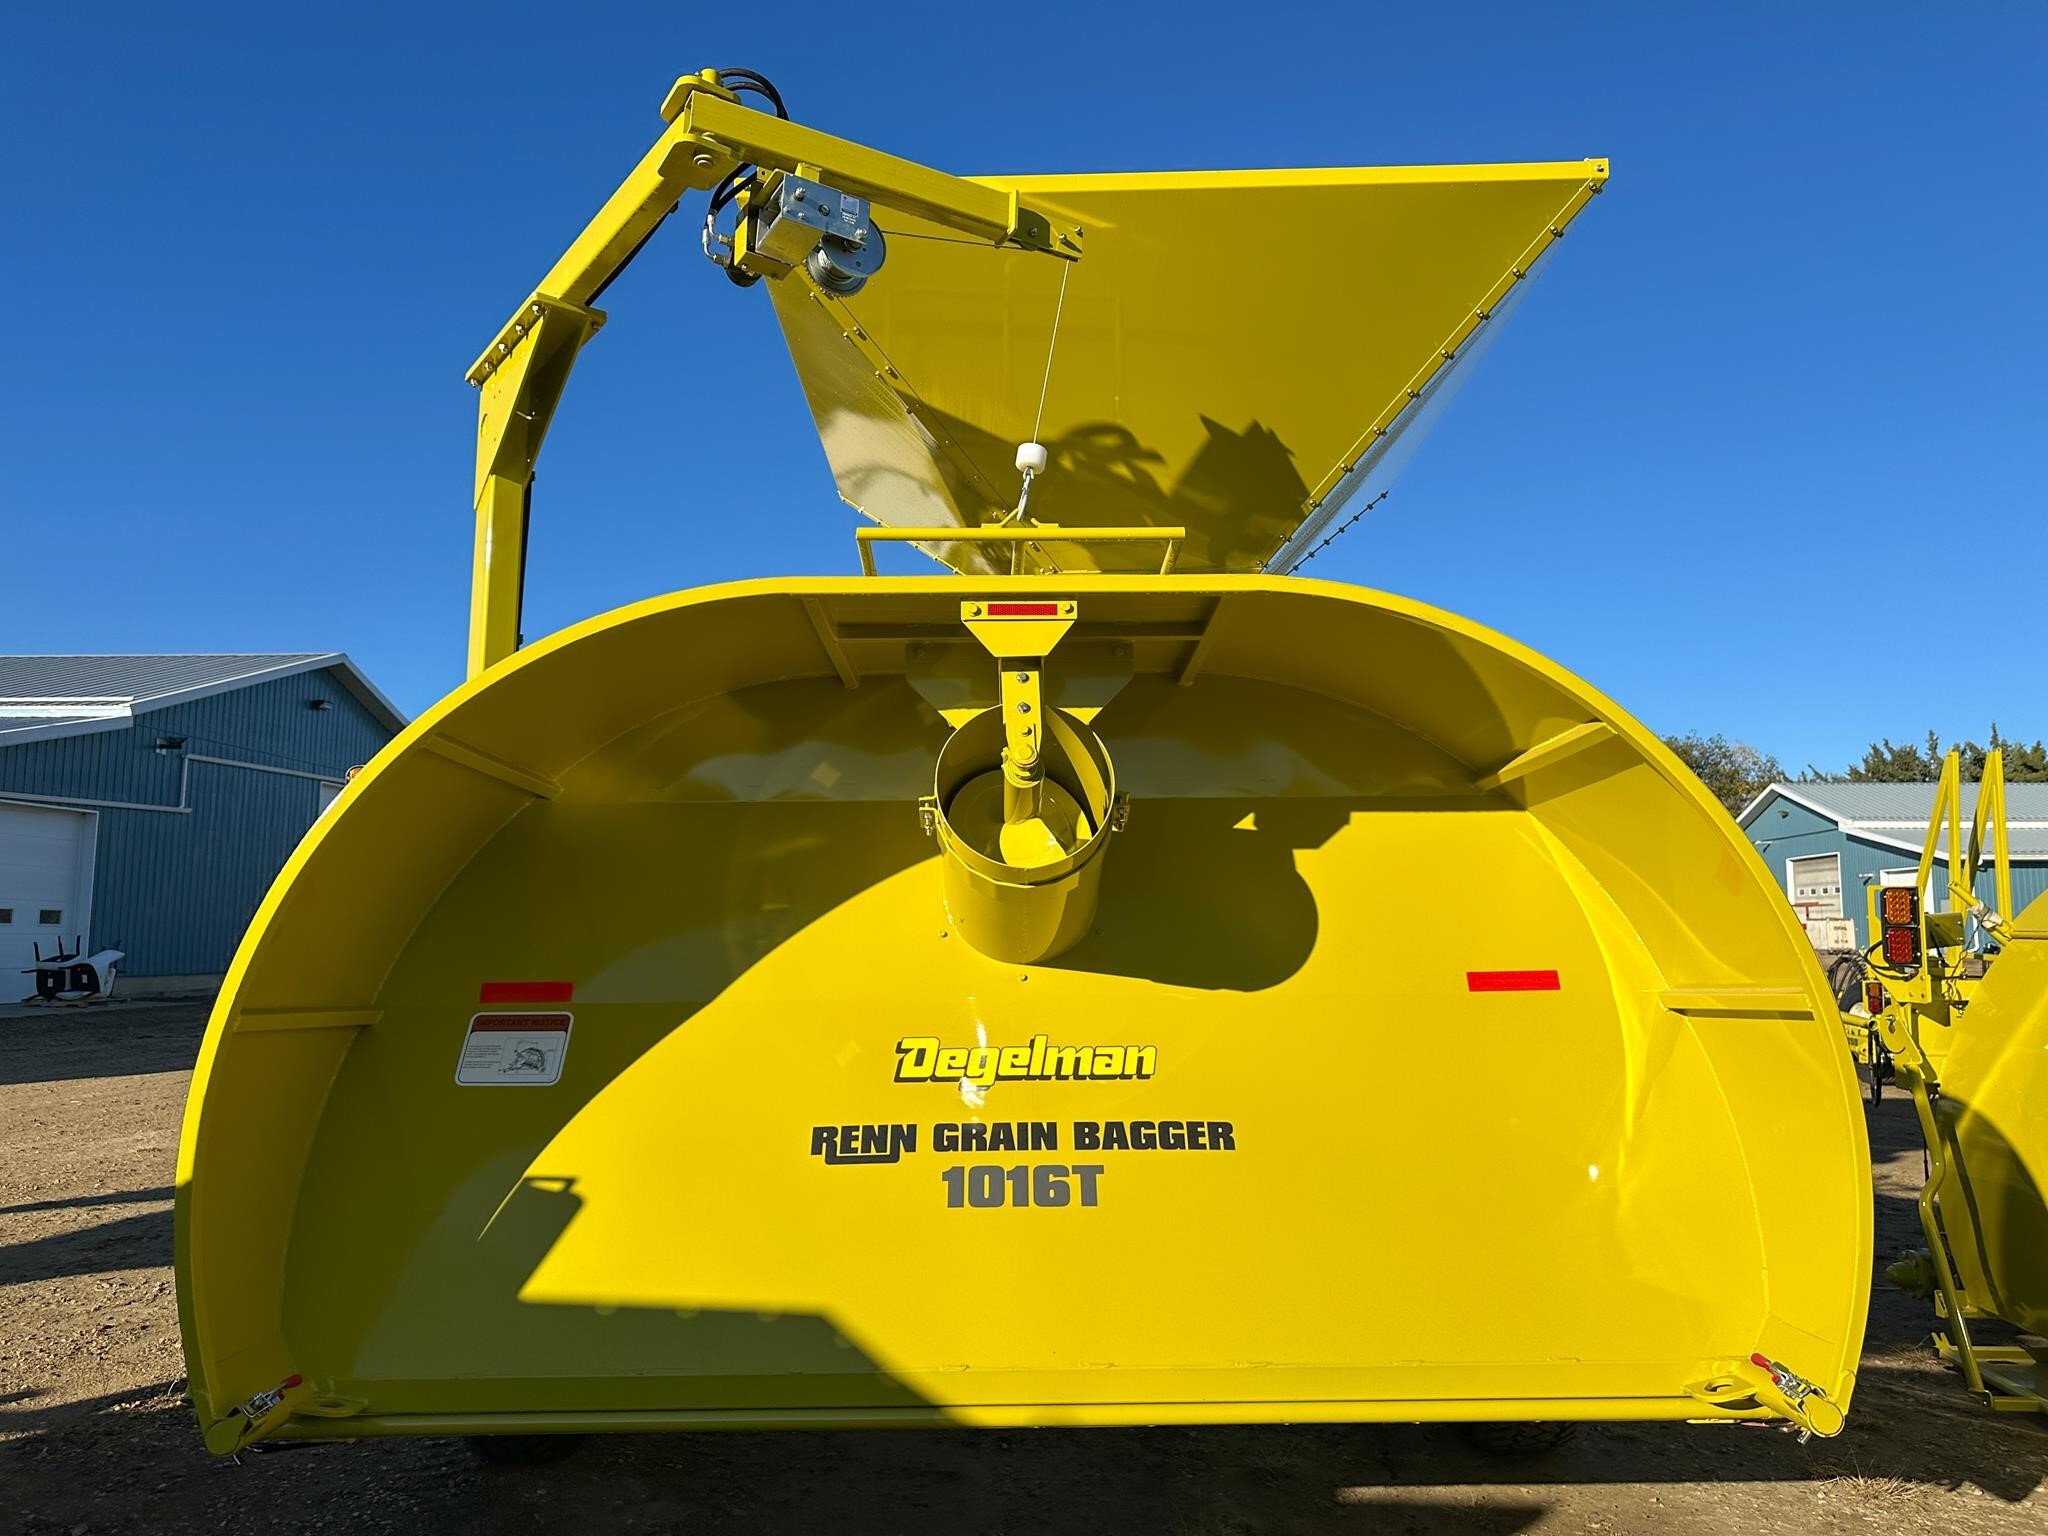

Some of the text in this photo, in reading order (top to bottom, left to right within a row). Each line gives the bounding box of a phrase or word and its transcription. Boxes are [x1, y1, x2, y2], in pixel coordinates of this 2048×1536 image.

[477, 1018, 565, 1026] IMPORTANT NOTICE
[894, 1034, 1157, 1091] Degelman
[810, 1121, 1236, 1165] RENN GRAIN BAGGER
[941, 1165, 1105, 1208] 1016T
